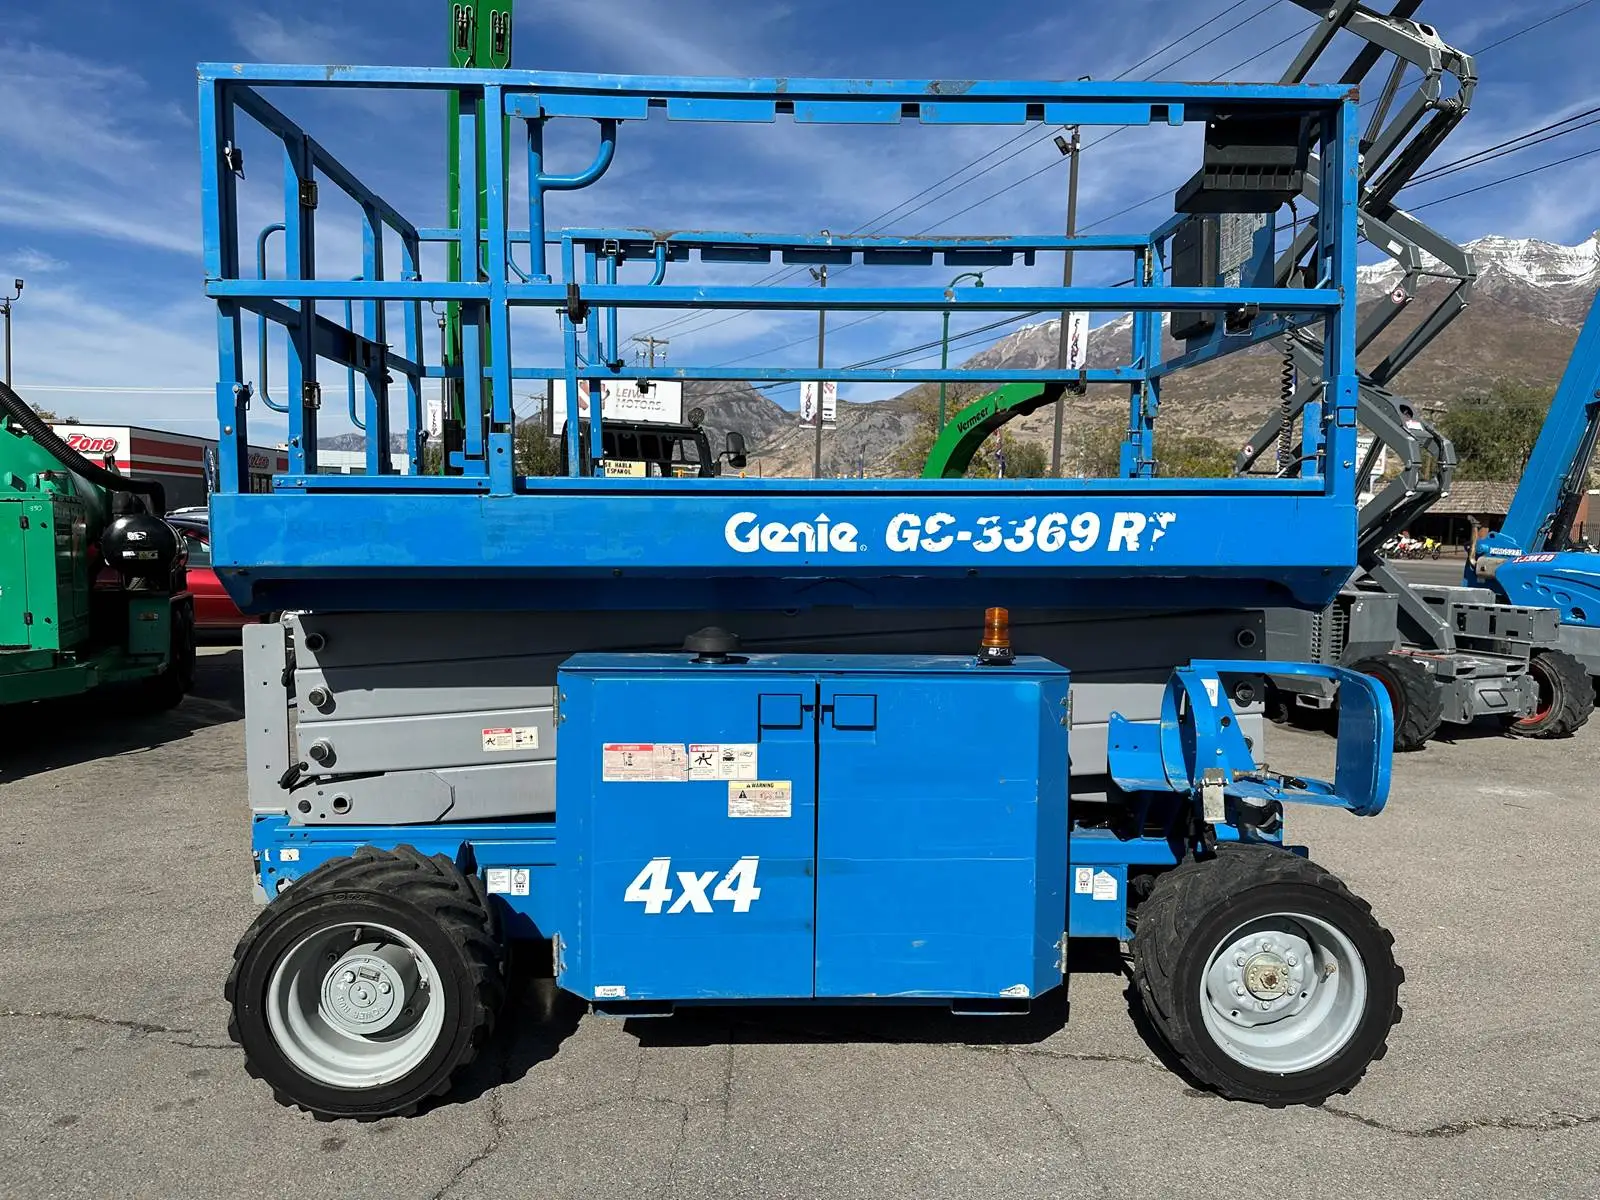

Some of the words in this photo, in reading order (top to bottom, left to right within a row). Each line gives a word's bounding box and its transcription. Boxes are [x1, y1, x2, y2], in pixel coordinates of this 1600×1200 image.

[615, 399, 662, 411] MOTORS
[957, 407, 989, 433] Vermeer
[724, 511, 859, 553] Genie
[885, 511, 1101, 553] GS-3369
[623, 855, 762, 914] 4x4
